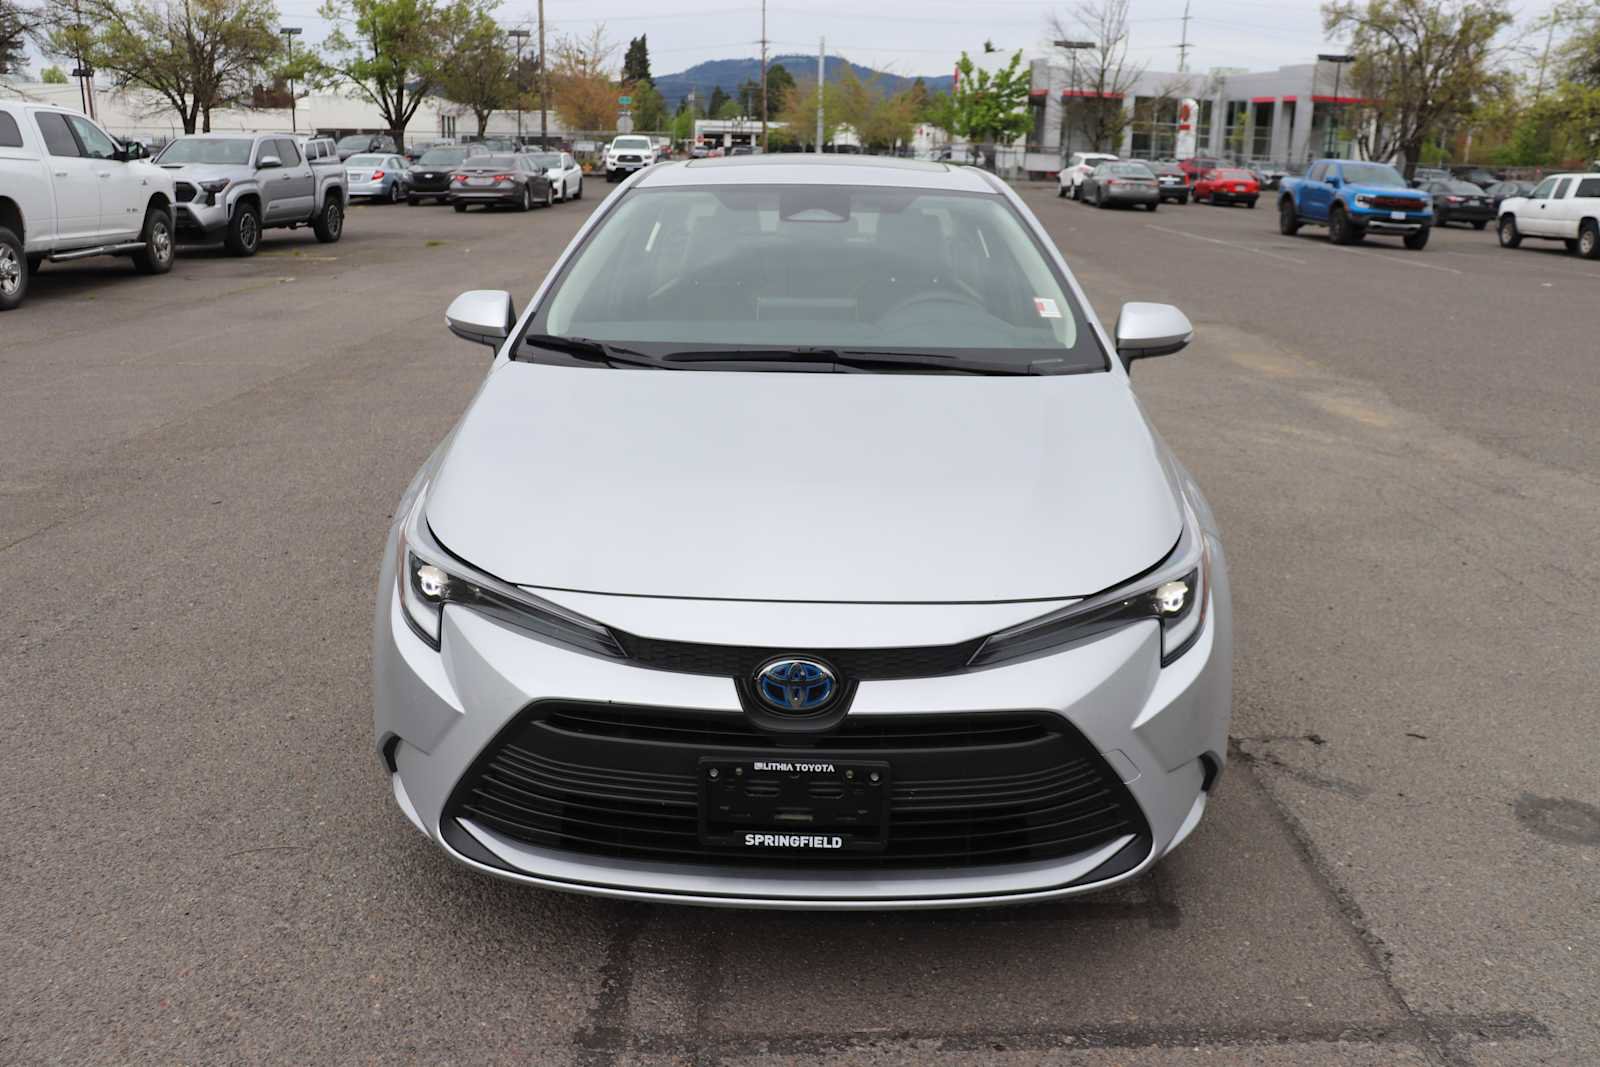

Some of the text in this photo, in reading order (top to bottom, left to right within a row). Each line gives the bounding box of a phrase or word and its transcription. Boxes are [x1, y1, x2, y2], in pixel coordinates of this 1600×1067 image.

[763, 762, 835, 772] LITHIA TOYOTA
[745, 834, 842, 848] SPRINGFIELD
